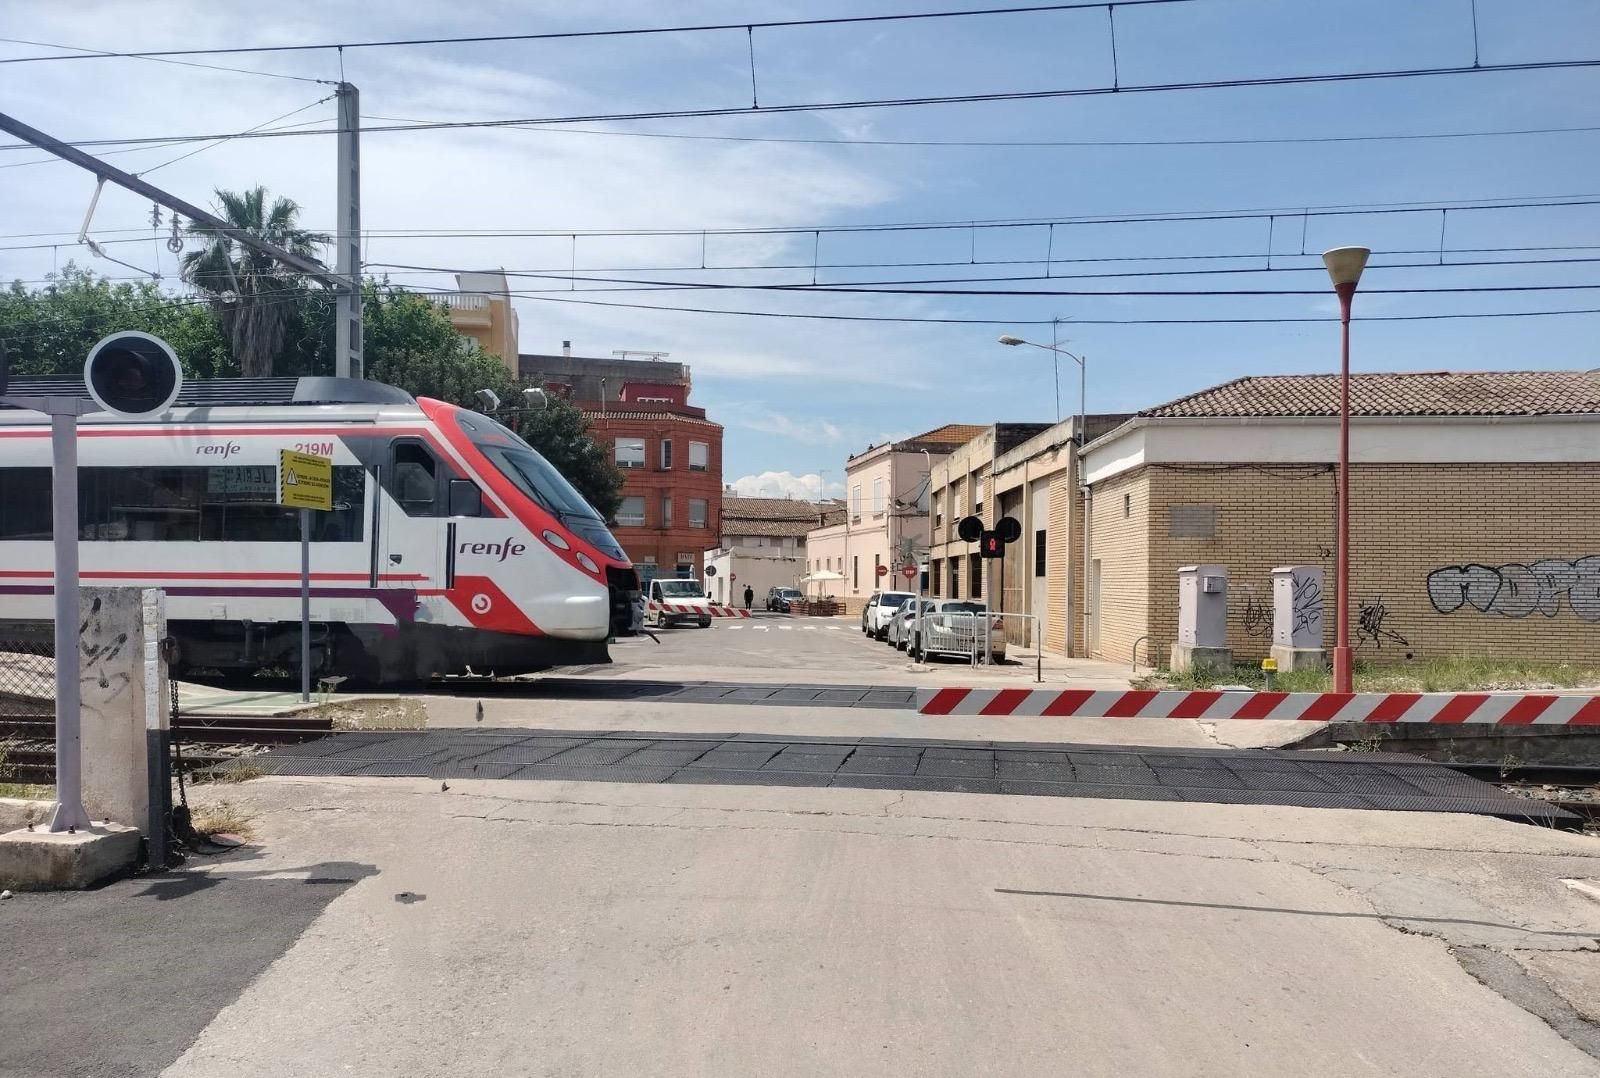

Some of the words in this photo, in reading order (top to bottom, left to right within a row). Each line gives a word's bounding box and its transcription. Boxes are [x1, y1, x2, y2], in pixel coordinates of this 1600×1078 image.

[196, 440, 241, 459] renfe
[295, 442, 334, 456] 219M
[459, 536, 526, 563] renfe
